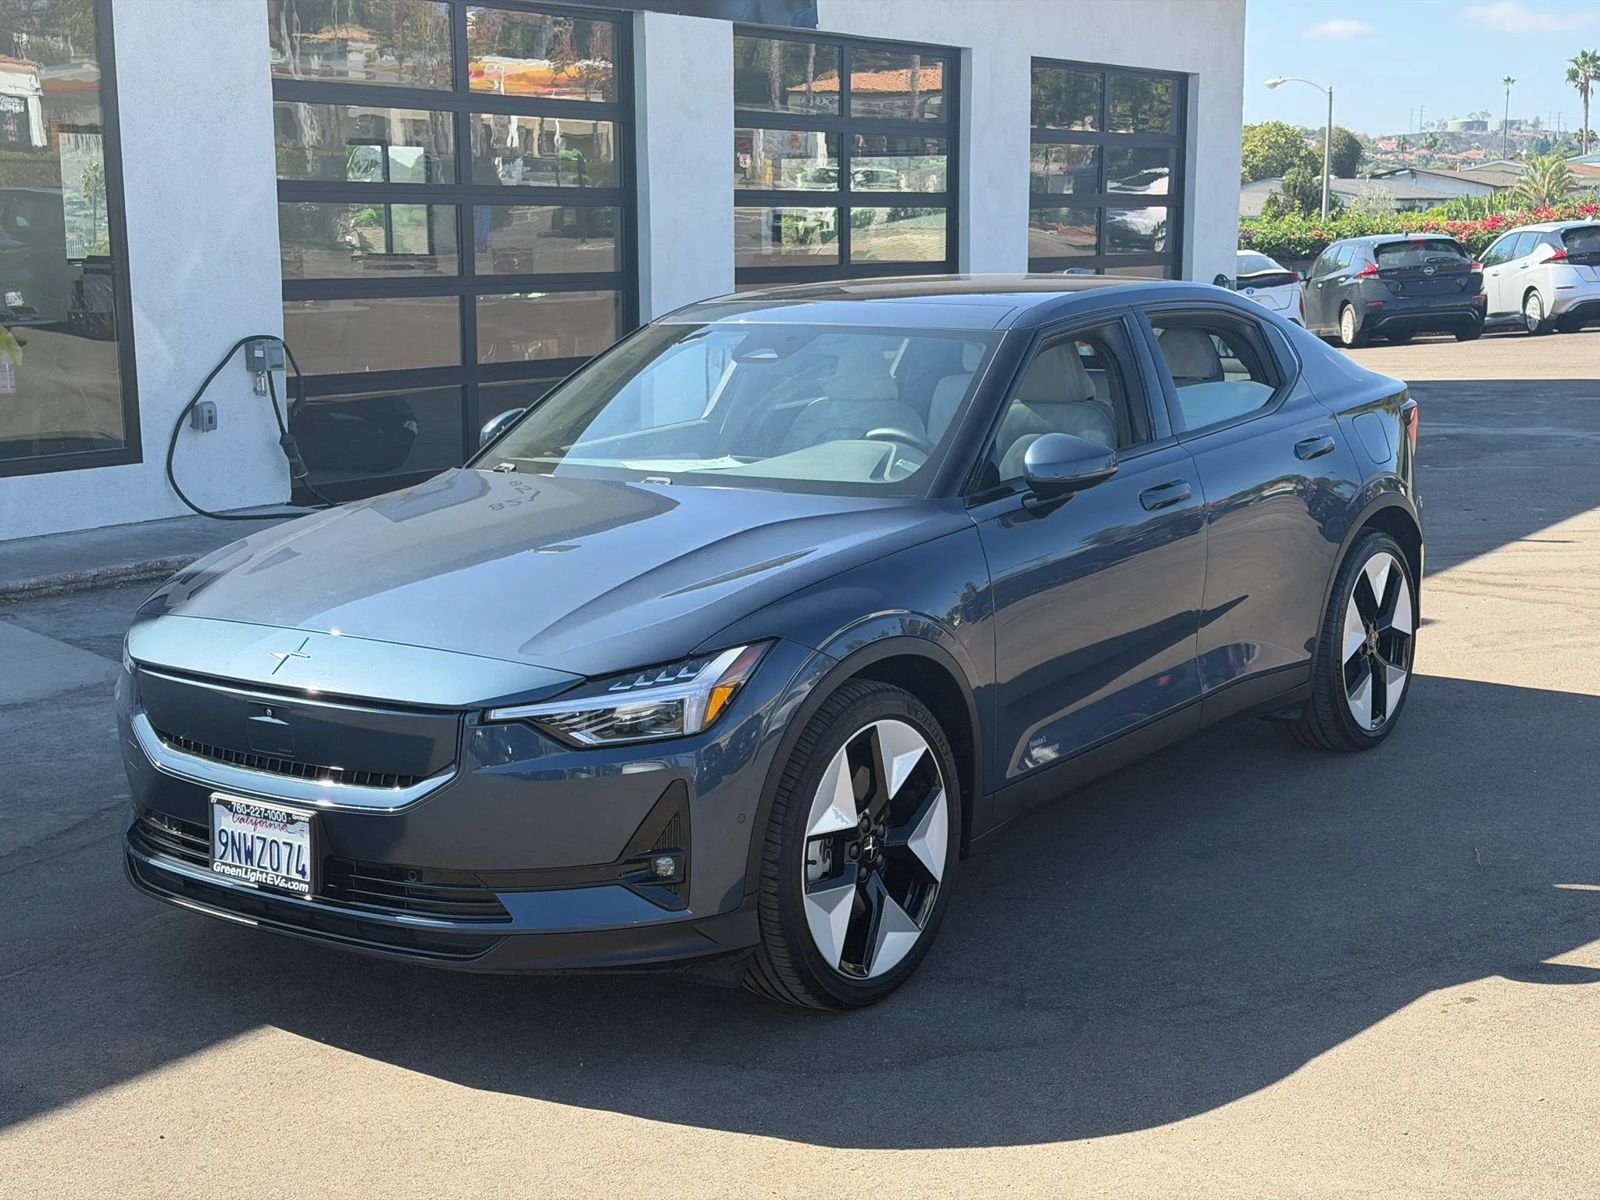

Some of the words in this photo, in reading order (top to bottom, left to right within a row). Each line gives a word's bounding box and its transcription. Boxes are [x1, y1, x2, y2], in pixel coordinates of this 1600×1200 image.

[231, 802, 287, 822] 760-227-1000
[218, 828, 307, 879] 9NWZ074
[213, 862, 309, 892] GreenLightEVs.com
